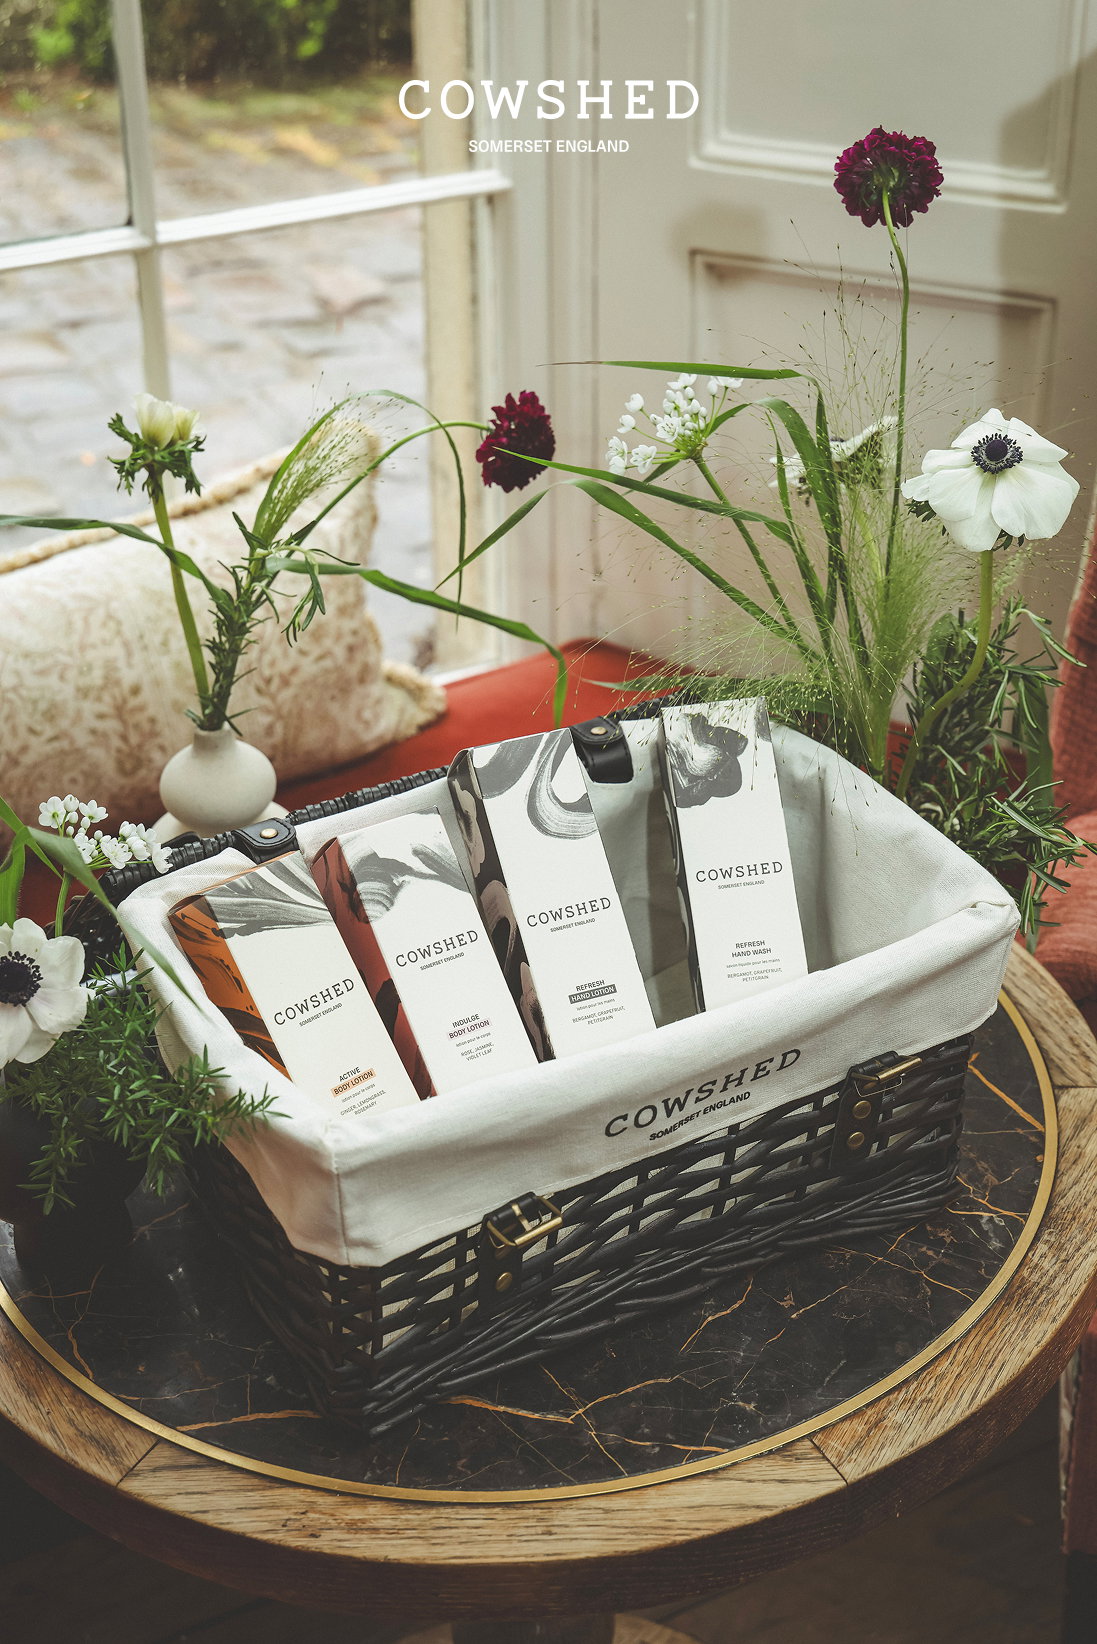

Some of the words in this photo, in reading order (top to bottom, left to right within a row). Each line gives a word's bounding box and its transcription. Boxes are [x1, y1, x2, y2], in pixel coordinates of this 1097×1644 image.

[696, 861, 783, 883] COWSHED
[718, 882, 743, 890] SOMERSET
[526, 897, 611, 928] COWSHED
[550, 922, 575, 933] SOMERSET
[574, 917, 596, 928] ENGLAND
[395, 929, 479, 967] COWSHED
[731, 950, 751, 958] HAND
[751, 947, 772, 956] WASH
[735, 940, 766, 949] REFRESH
[420, 958, 444, 971] SOMERSET
[443, 951, 465, 964] ENGLAND
[571, 992, 591, 1002] HAND
[590, 985, 615, 997] LOTION
[575, 979, 605, 992] REFRESH
[273, 978, 355, 1026] COWSHED
[299, 1012, 322, 1027] SOMERSET
[321, 1002, 343, 1016] ENGLAND
[452, 1013, 480, 1029] INDULGE
[587, 1014, 614, 1025] PETITGRAIN
[448, 1027, 466, 1039] BODY
[466, 1019, 490, 1033] LOTION
[461, 1048, 475, 1057] ROSE,
[474, 1041, 494, 1052] JASMINE,
[466, 1052, 482, 1061] VIOLET
[481, 1048, 492, 1056] LEAF
[339, 1066, 361, 1082] ACTIVE
[333, 1081, 351, 1095] BODY
[350, 1070, 374, 1086] LOTION
[604, 1048, 801, 1138] COWSHED
[354, 1100, 377, 1115] ROSEMARY
[649, 1110, 702, 1141] SOMERSET
[702, 1091, 751, 1115] ENGLAND
